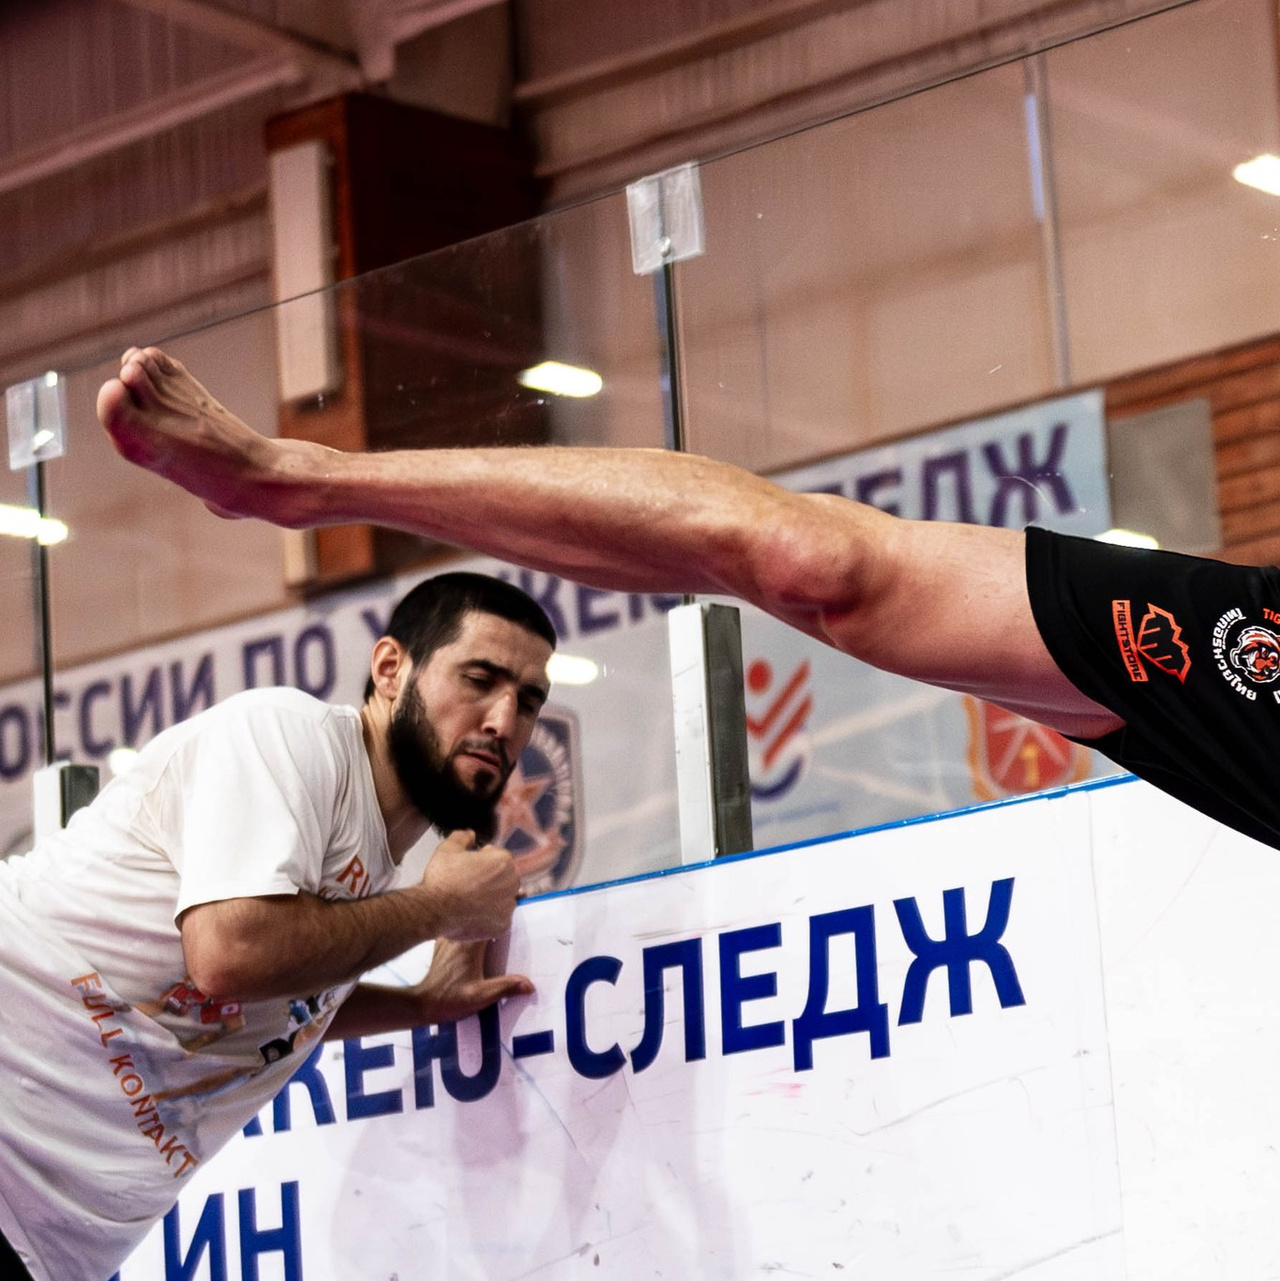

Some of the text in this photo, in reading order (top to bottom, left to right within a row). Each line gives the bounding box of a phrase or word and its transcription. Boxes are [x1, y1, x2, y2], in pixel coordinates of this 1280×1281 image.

[243, 623, 337, 701] ПО
[1115, 601, 1144, 681] FIGHTSTORE
[70, 972, 199, 1179] FULL KONTAKT
[241, 876, 1027, 1139] КЕЮ-СЛЕДЖ
